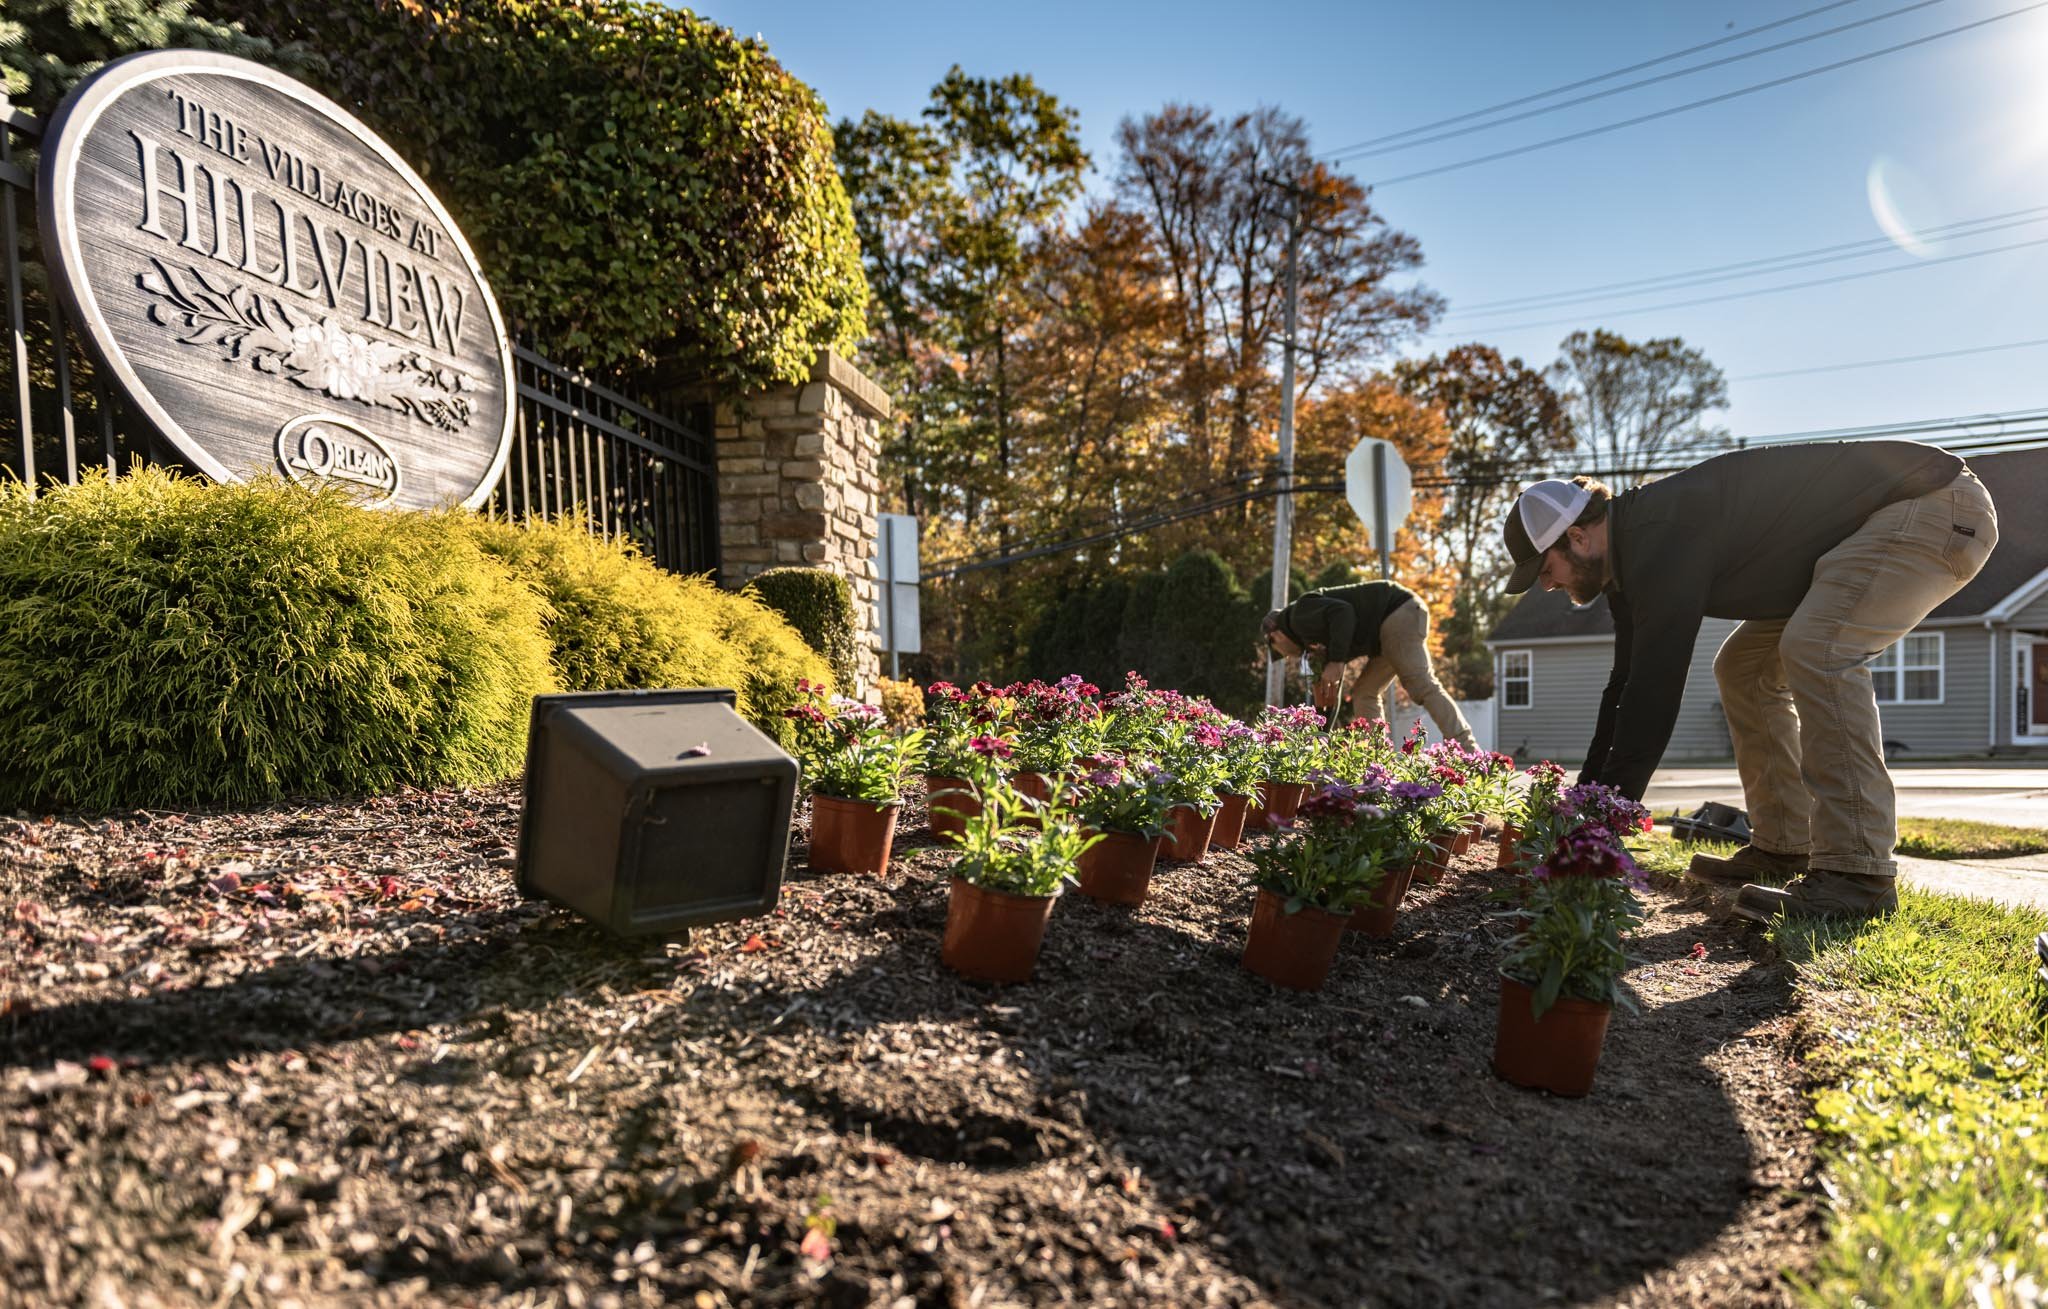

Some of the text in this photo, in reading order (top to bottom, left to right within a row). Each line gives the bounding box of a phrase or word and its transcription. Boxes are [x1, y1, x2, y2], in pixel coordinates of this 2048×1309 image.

[127, 130, 471, 356] HILLVIEW
[169, 89, 442, 262] THE VILLAGES AT
[299, 427, 394, 489] ORLEANS
